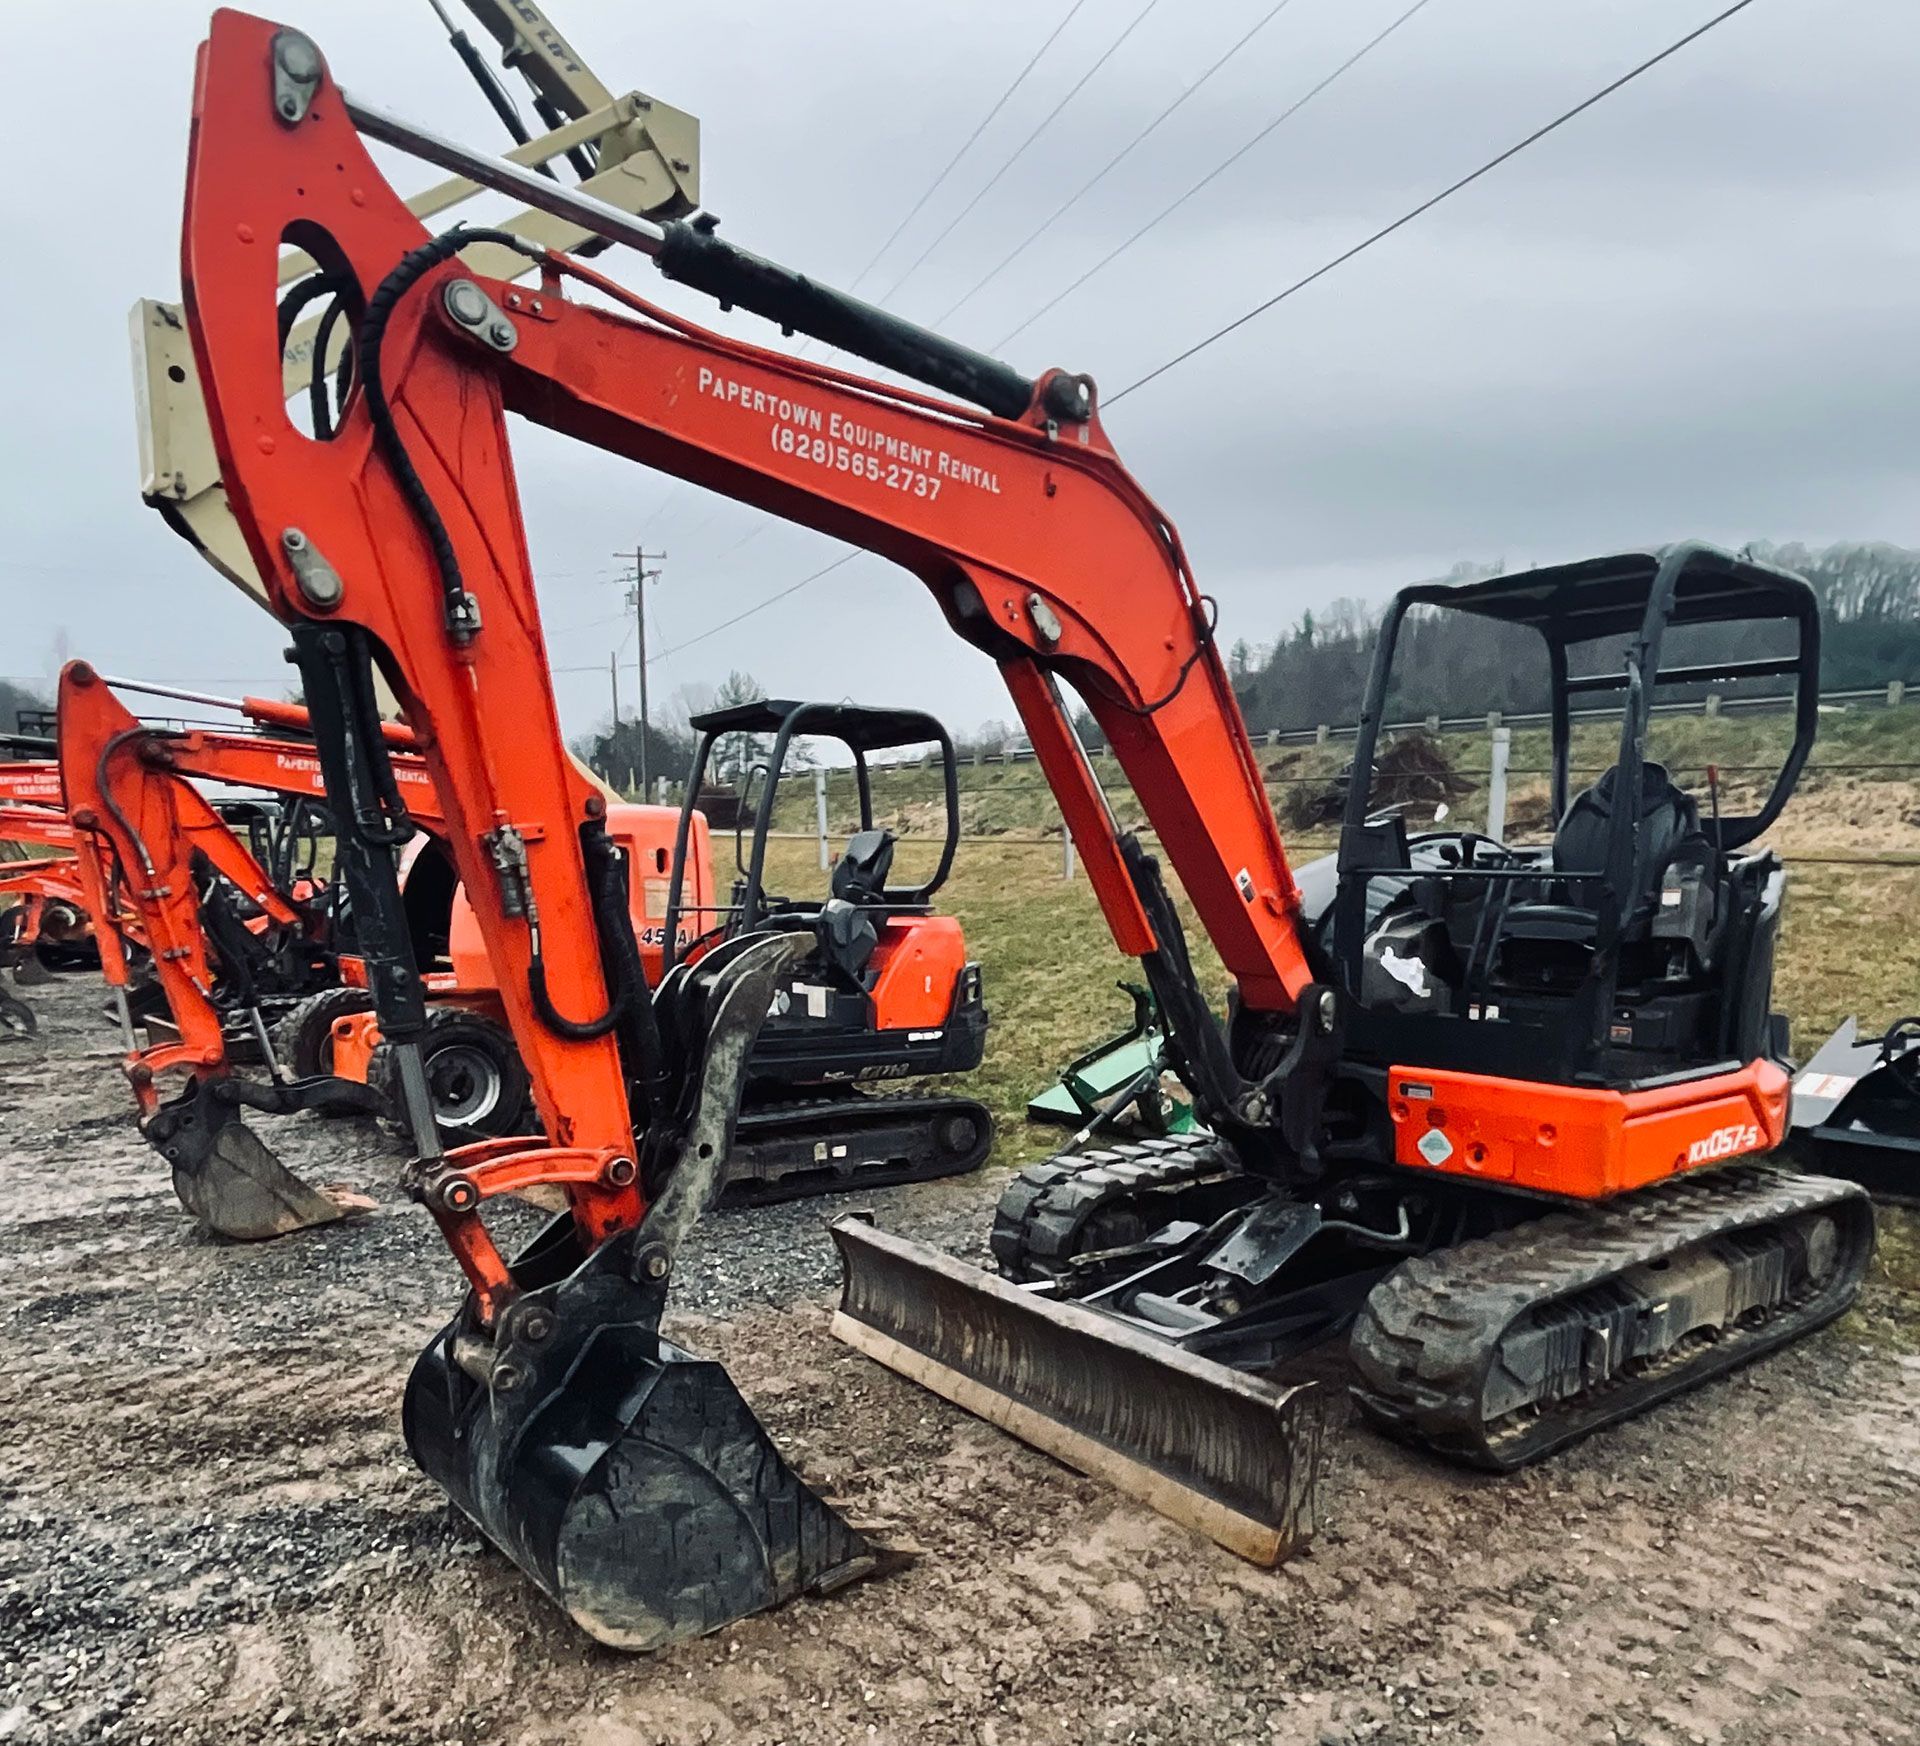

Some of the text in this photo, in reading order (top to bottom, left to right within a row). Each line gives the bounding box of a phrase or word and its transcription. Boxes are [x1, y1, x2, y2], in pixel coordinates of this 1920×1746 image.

[698, 367, 1001, 494] PAPERTOWN EQUIPMENT RENTAL
[770, 422, 942, 501] (828)565-2737
[276, 754, 321, 772] PAPERTO
